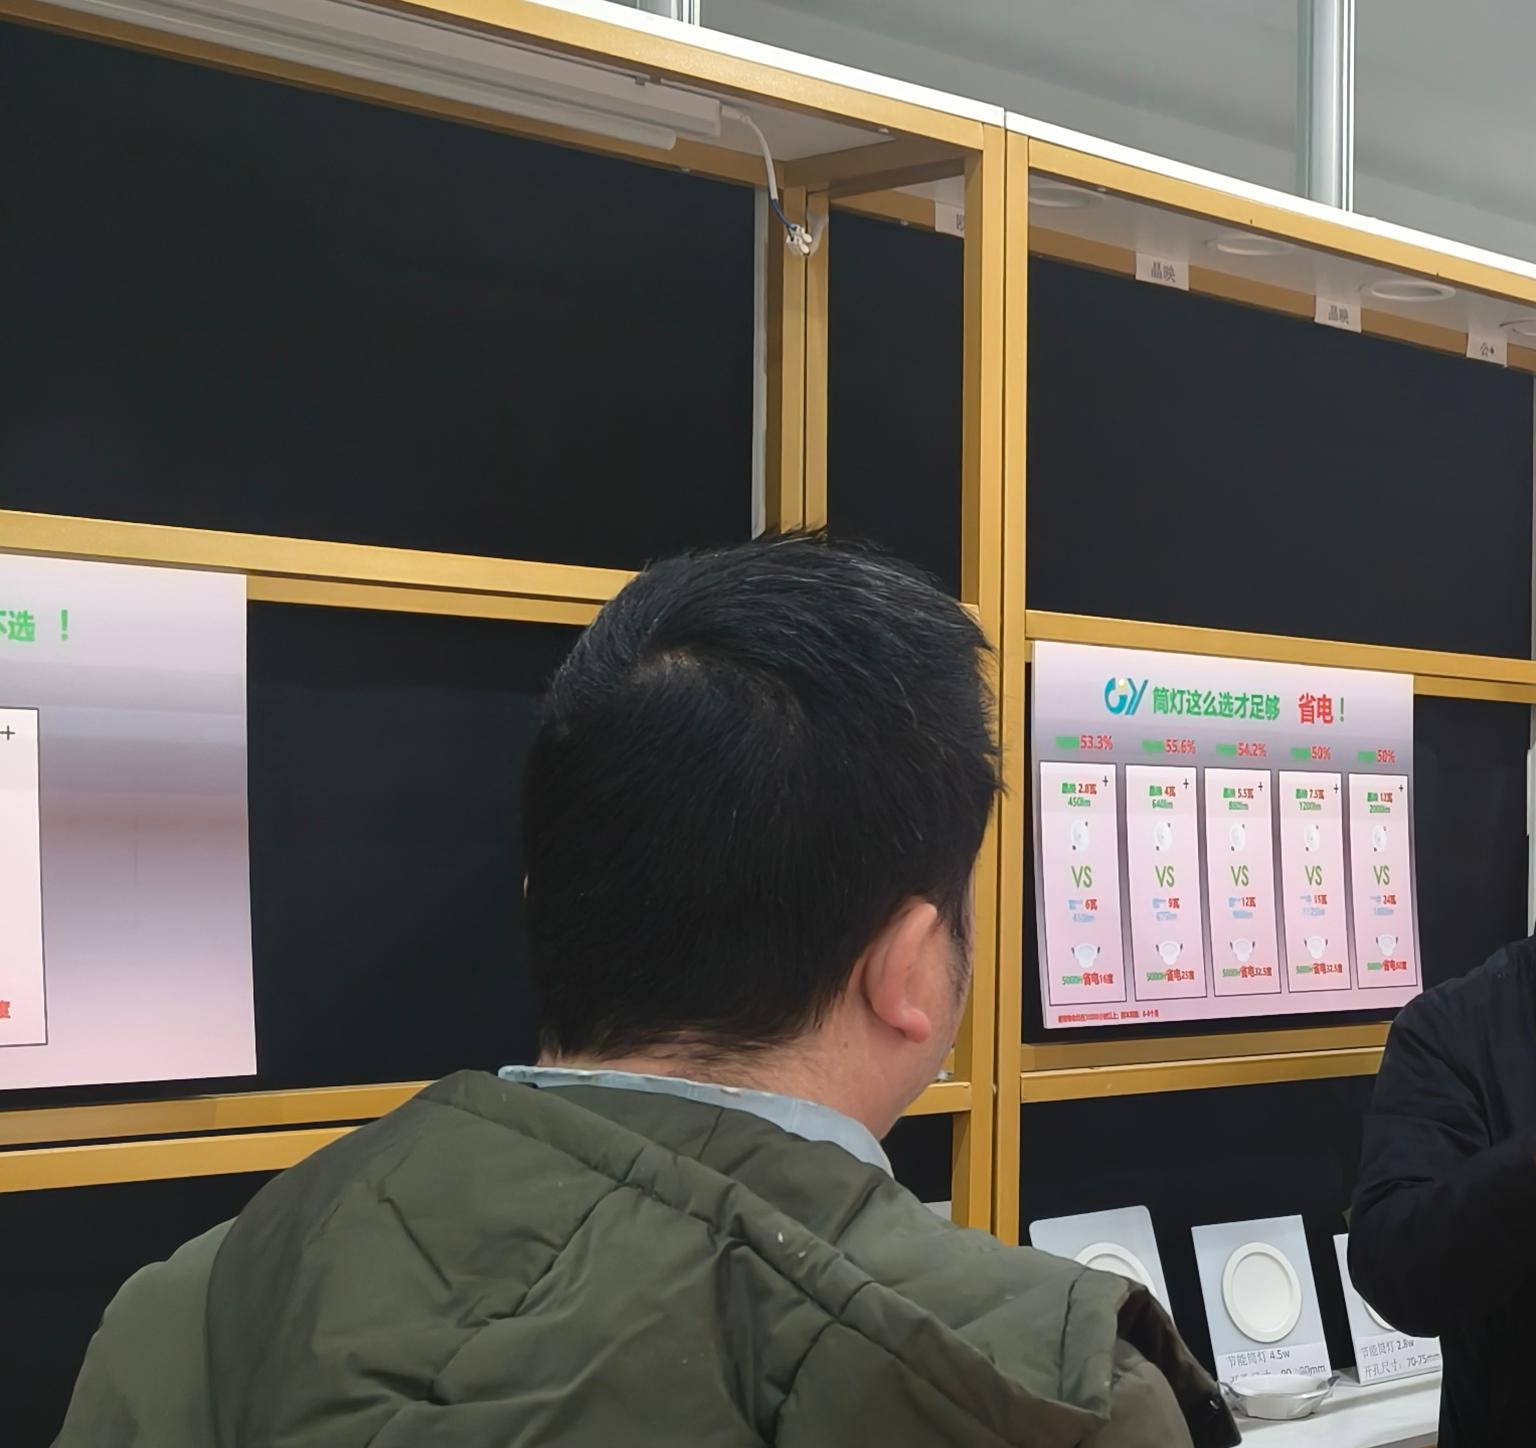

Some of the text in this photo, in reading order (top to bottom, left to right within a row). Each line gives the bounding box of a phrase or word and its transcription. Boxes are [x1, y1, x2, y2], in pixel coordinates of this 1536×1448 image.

[1151, 261, 1176, 283] 晶映
[1080, 735, 1113, 750] 53.3%
[1164, 739, 1195, 754] 55.6%
[1237, 742, 1266, 757] 54.2%
[1311, 746, 1331, 760] 50%
[1376, 749, 1395, 763] 50%
[1071, 865, 1093, 888] VS
[1155, 865, 1175, 888] VS
[1230, 865, 1249, 887] VS
[1305, 865, 1323, 886] VS
[1373, 864, 1391, 886] VS
